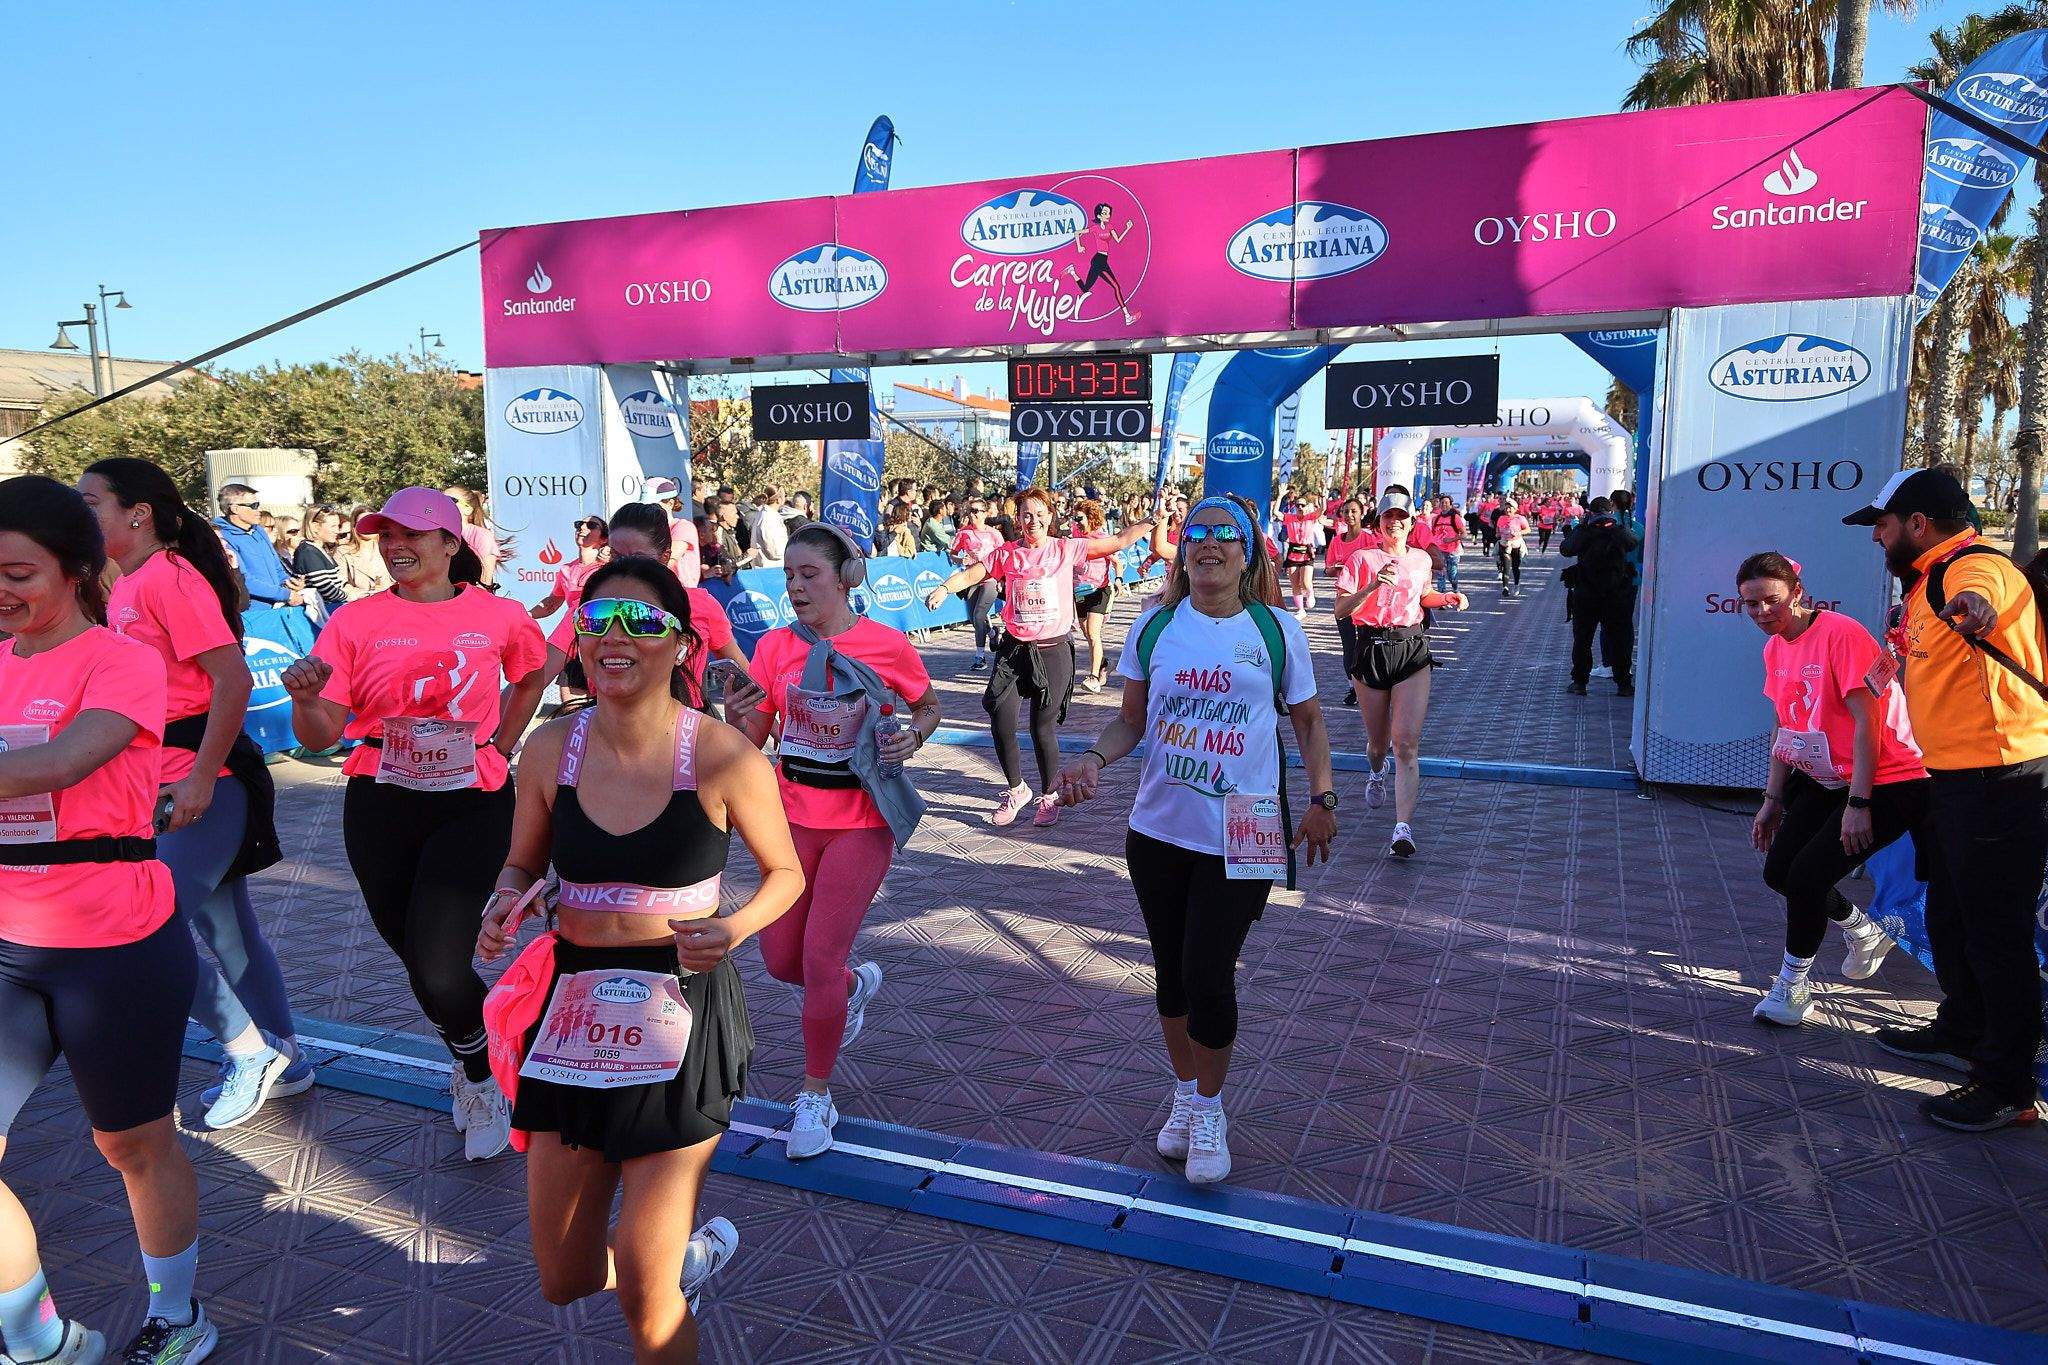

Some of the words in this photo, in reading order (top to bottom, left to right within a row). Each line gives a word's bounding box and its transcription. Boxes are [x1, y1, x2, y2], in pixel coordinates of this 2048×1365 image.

[1962, 80, 2045, 118] ASTURIANA
[1927, 145, 2008, 183] ASTURIANA
[990, 212, 1029, 222] CENTRAL
[1033, 207, 1074, 218] LECHERA
[1711, 198, 1868, 230] Santander
[971, 216, 1077, 241] ASTURIANA
[1318, 223, 1371, 237] LECHERA
[1473, 208, 1618, 246] OYSHO
[1238, 235, 1375, 265] ASTURIANA
[950, 254, 1054, 288] Carrera
[624, 279, 713, 306] OYSHO
[778, 271, 878, 297] ASTURIANA
[503, 295, 577, 316] Santander
[975, 288, 995, 312] de
[998, 286, 1013, 311] la
[1008, 280, 1092, 336] Mujer
[1745, 357, 1796, 367] CENTRAL
[1802, 354, 1854, 364] LECHERA
[1015, 361, 1139, 396] 00:43:32
[1719, 361, 1858, 387] ASTURIANA
[1352, 380, 1473, 410] OYSHO
[511, 406, 579, 424] ASTURIANA
[769, 401, 853, 426] OYSHO
[1016, 408, 1145, 438] OYSHO
[1210, 442, 1261, 456] ASTURIANA
[505, 475, 587, 497] OYSHO
[1696, 460, 1864, 492] OYSHO
[518, 567, 558, 582] Santa
[375, 637, 418, 650] OYSHO
[1174, 664, 1232, 693] #MÁS
[1158, 695, 1251, 724] INVESTIGACIÓN
[810, 722, 840, 736] 016
[1157, 720, 1198, 750] PARA
[1203, 725, 1245, 756] MÁS
[411, 747, 449, 763] 016
[679, 714, 696, 776] NIKE
[790, 746, 818, 756] OYSHO
[1165, 752, 1209, 783] VIDA
[7, 813, 35, 821] VALENCIA
[1, 829, 39, 837] Santander
[1255, 831, 1282, 846] 016
[1237, 866, 1265, 874] OYSHO
[569, 886, 645, 906] NIKE
[646, 882, 717, 908] PRO
[595, 987, 647, 999] ASTURIANA
[587, 1023, 644, 1047] 016
[547, 1057, 580, 1068] CARRERA
[600, 1062, 625, 1071] MUJER
[593, 1049, 621, 1059] 9059
[539, 1067, 588, 1082] OYSHO
[616, 1073, 661, 1083] Santander
